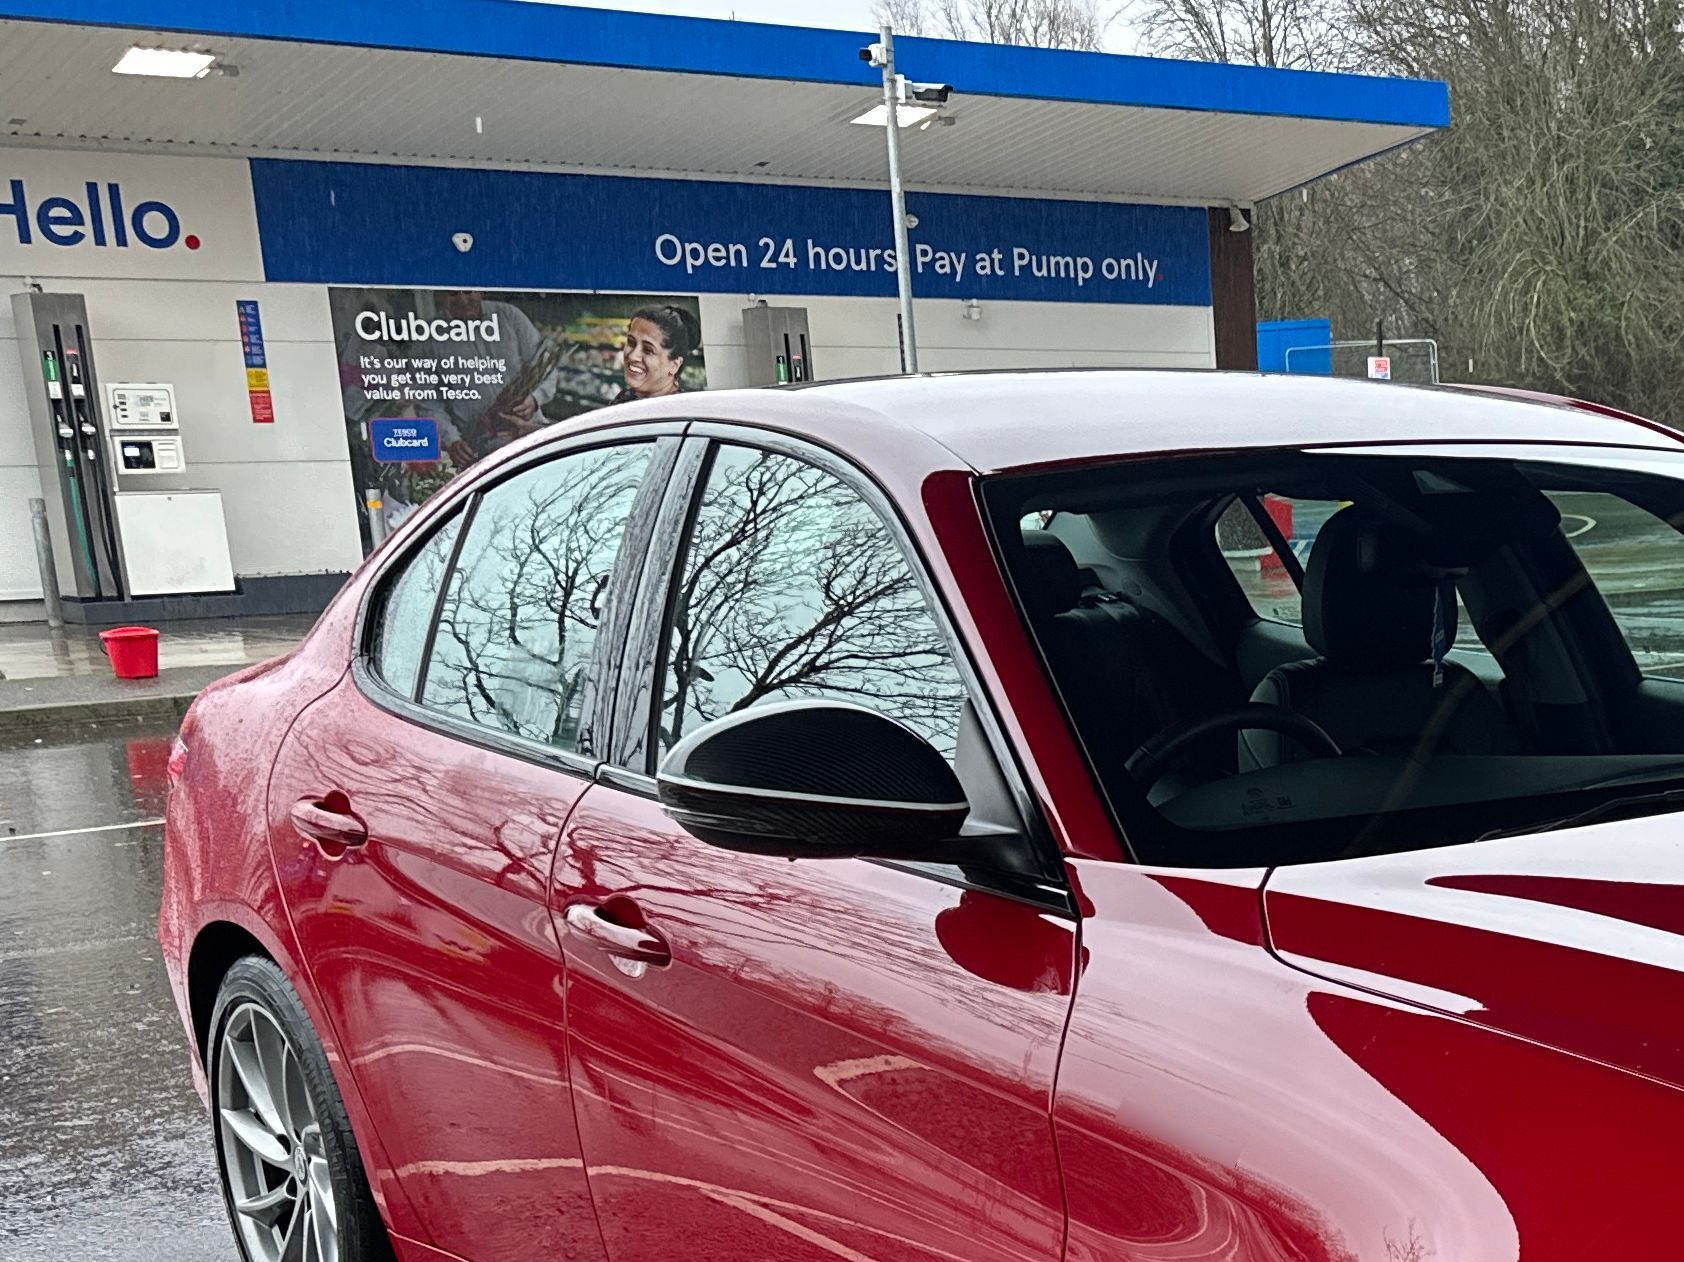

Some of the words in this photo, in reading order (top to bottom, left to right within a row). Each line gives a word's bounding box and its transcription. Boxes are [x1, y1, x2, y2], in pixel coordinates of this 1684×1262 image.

[0, 179, 201, 250] Hello.
[655, 233, 748, 274] Open
[758, 237, 798, 269] 24
[807, 238, 898, 272] hours
[915, 243, 966, 282] Pay
[975, 247, 1005, 276] at
[1012, 247, 1093, 287] Pump
[354, 311, 501, 342] Clubcard
[359, 355, 381, 369] It's
[384, 358, 408, 369] our
[411, 358, 437, 371] way
[441, 356, 455, 369] of
[458, 356, 506, 372] helping
[361, 374, 386, 387] you
[391, 373, 413, 386] get
[415, 371, 439, 385] the
[441, 373, 471, 387] very
[474, 371, 504, 385] best
[363, 387, 401, 400] value
[404, 387, 437, 400] from
[439, 387, 482, 400] Tesco.
[383, 437, 429, 448] Clubcard
